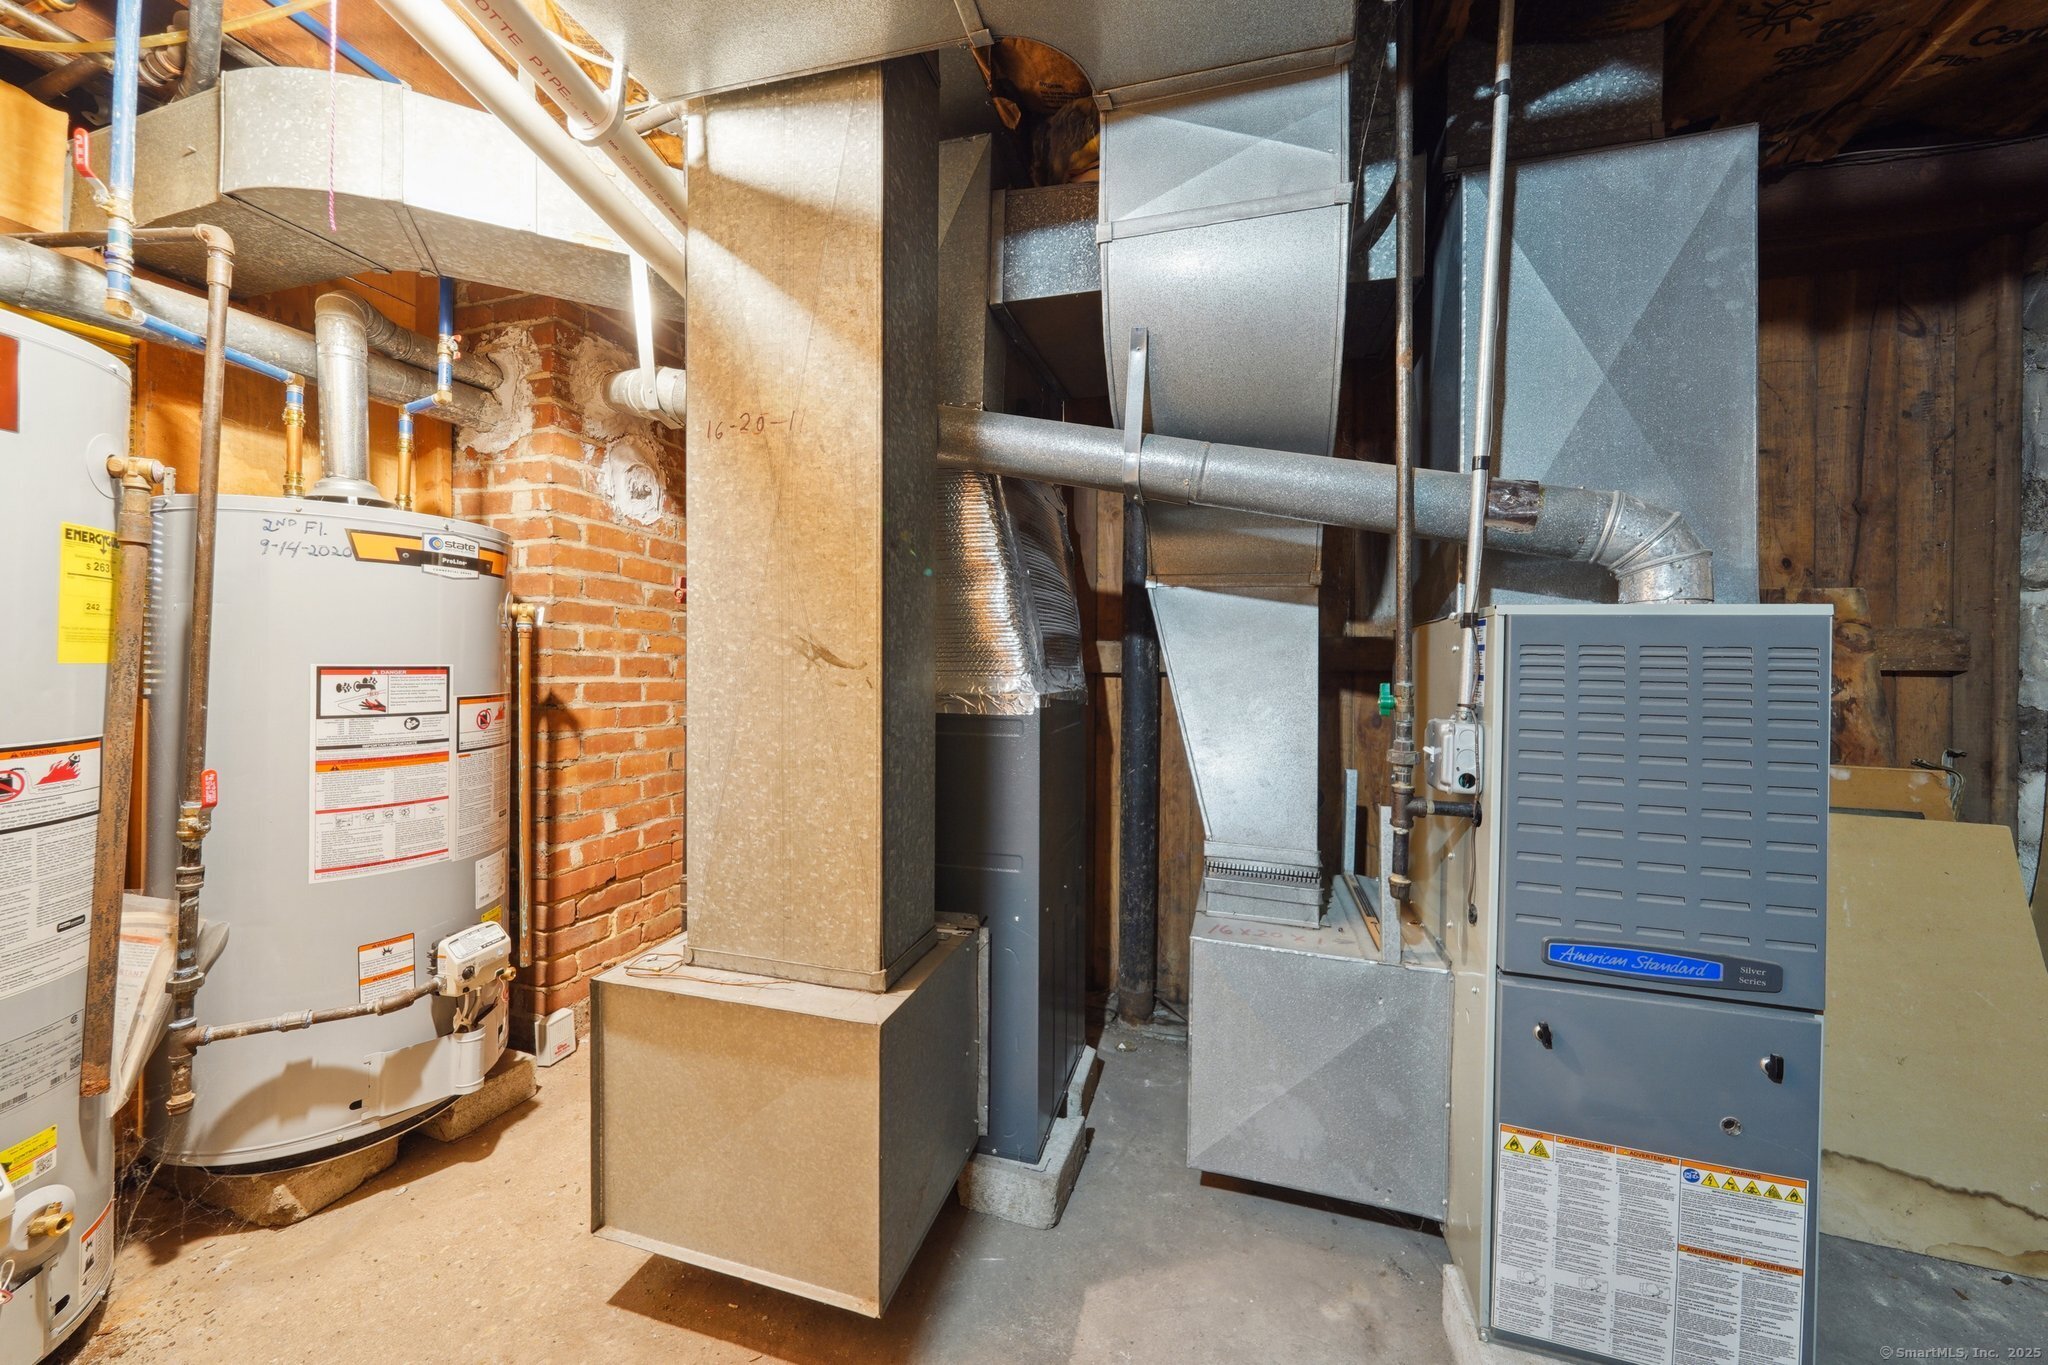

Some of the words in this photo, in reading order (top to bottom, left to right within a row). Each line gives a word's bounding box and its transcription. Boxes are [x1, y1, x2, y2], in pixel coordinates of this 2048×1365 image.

[529, 55, 572, 98] PIPE
[262, 518, 297, 532] 2ND
[260, 539, 353, 558] 9-14-2020
[444, 540, 476, 553] state
[93, 561, 110, 573] 263
[442, 557, 467, 566] ProLine
[86, 602, 100, 611] 242
[20, 748, 57, 758] WARNING
[1208, 923, 1233, 935] 16
[1559, 946, 1628, 967] American
[1631, 955, 1710, 977] Standard
[1740, 966, 1767, 976] Silver
[1738, 976, 1767, 987] Series
[1516, 1129, 1544, 1139] WARNING
[1563, 1138, 1612, 1152] AVERTISSEMENT
[1629, 1150, 1673, 1164] ADVERTENCIA
[1730, 1169, 1761, 1180] WARNING
[1686, 1247, 1739, 1262] AVERTISSEMENT
[1753, 1261, 1799, 1274] ADVERTENCIA
